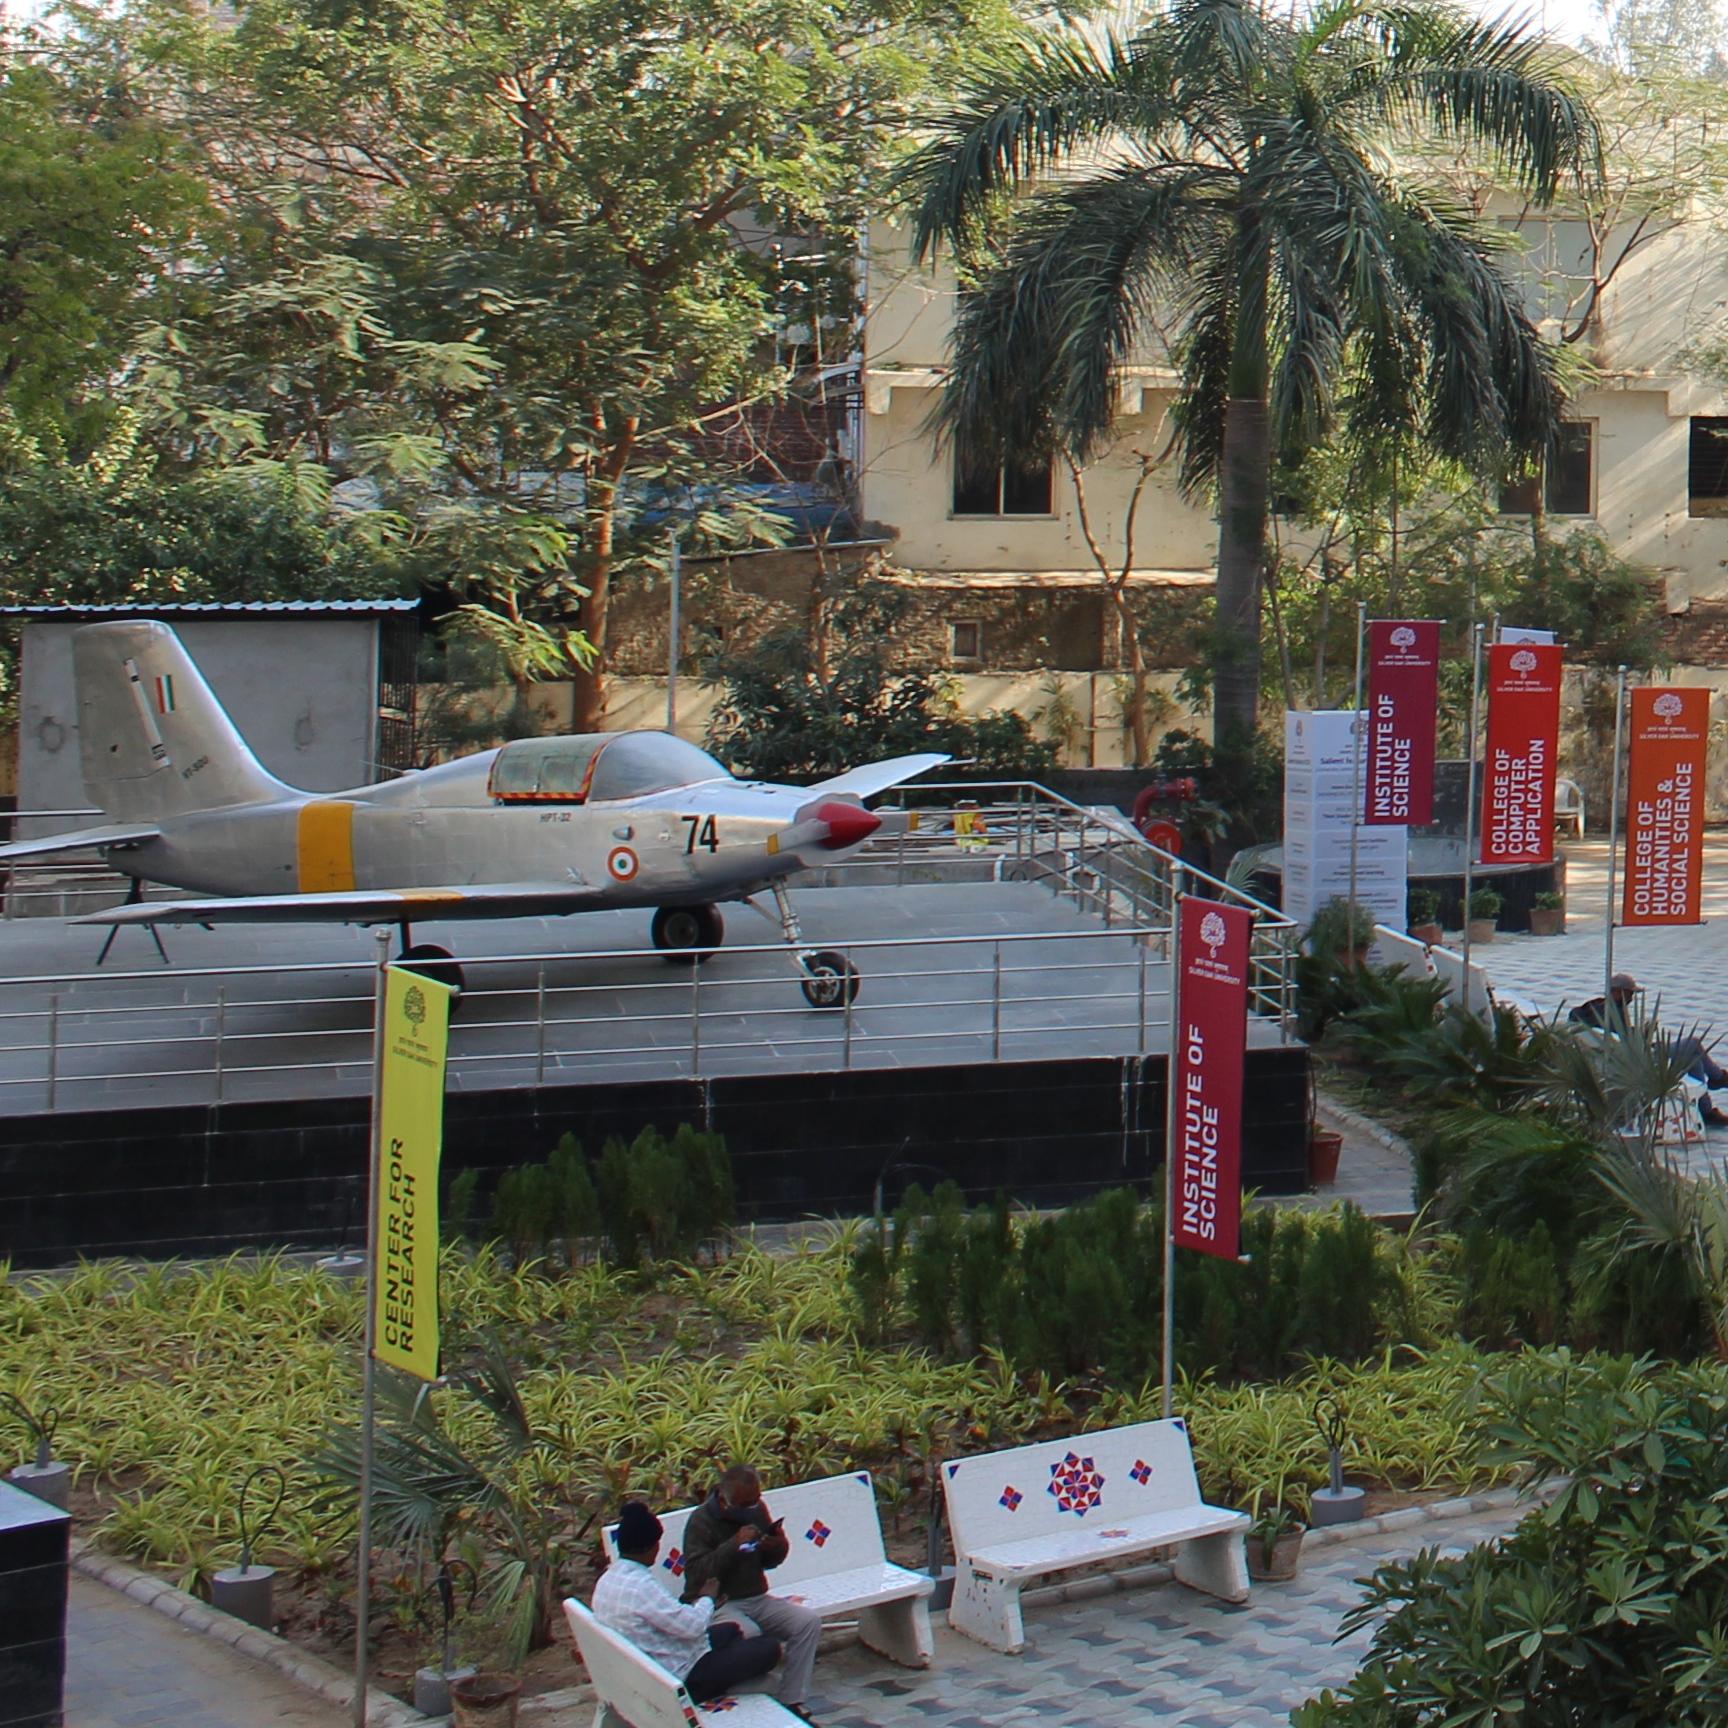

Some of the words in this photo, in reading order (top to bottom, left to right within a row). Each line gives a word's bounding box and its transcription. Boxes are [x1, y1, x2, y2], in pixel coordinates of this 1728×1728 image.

[1377, 694, 1394, 718] OF
[1374, 722, 1393, 816] INSTITUTE
[1392, 738, 1410, 816] SCIENCE
[1495, 748, 1510, 771] OF
[1525, 740, 1545, 854] APPLICATION
[1657, 779, 1673, 793] &
[540, 813, 572, 822] HPT-32
[682, 814, 719, 854] 74
[1491, 775, 1509, 854] COLLEGE
[1508, 758, 1527, 854] COMPUTER
[1637, 801, 1653, 825] OF
[1673, 763, 1692, 843] SCIENCE
[1634, 830, 1653, 915] COLLEGE
[1652, 797, 1672, 915] HUMANITIES
[1670, 848, 1688, 915] SOCIAL
[1188, 1024, 1206, 1065] OF
[389, 1137, 405, 1206] FOR
[1183, 1072, 1203, 1234] INSTITUTE
[1200, 1104, 1219, 1241] SCIENCE
[385, 1213, 401, 1347] CENTER
[400, 1173, 416, 1353] RESEARCH
